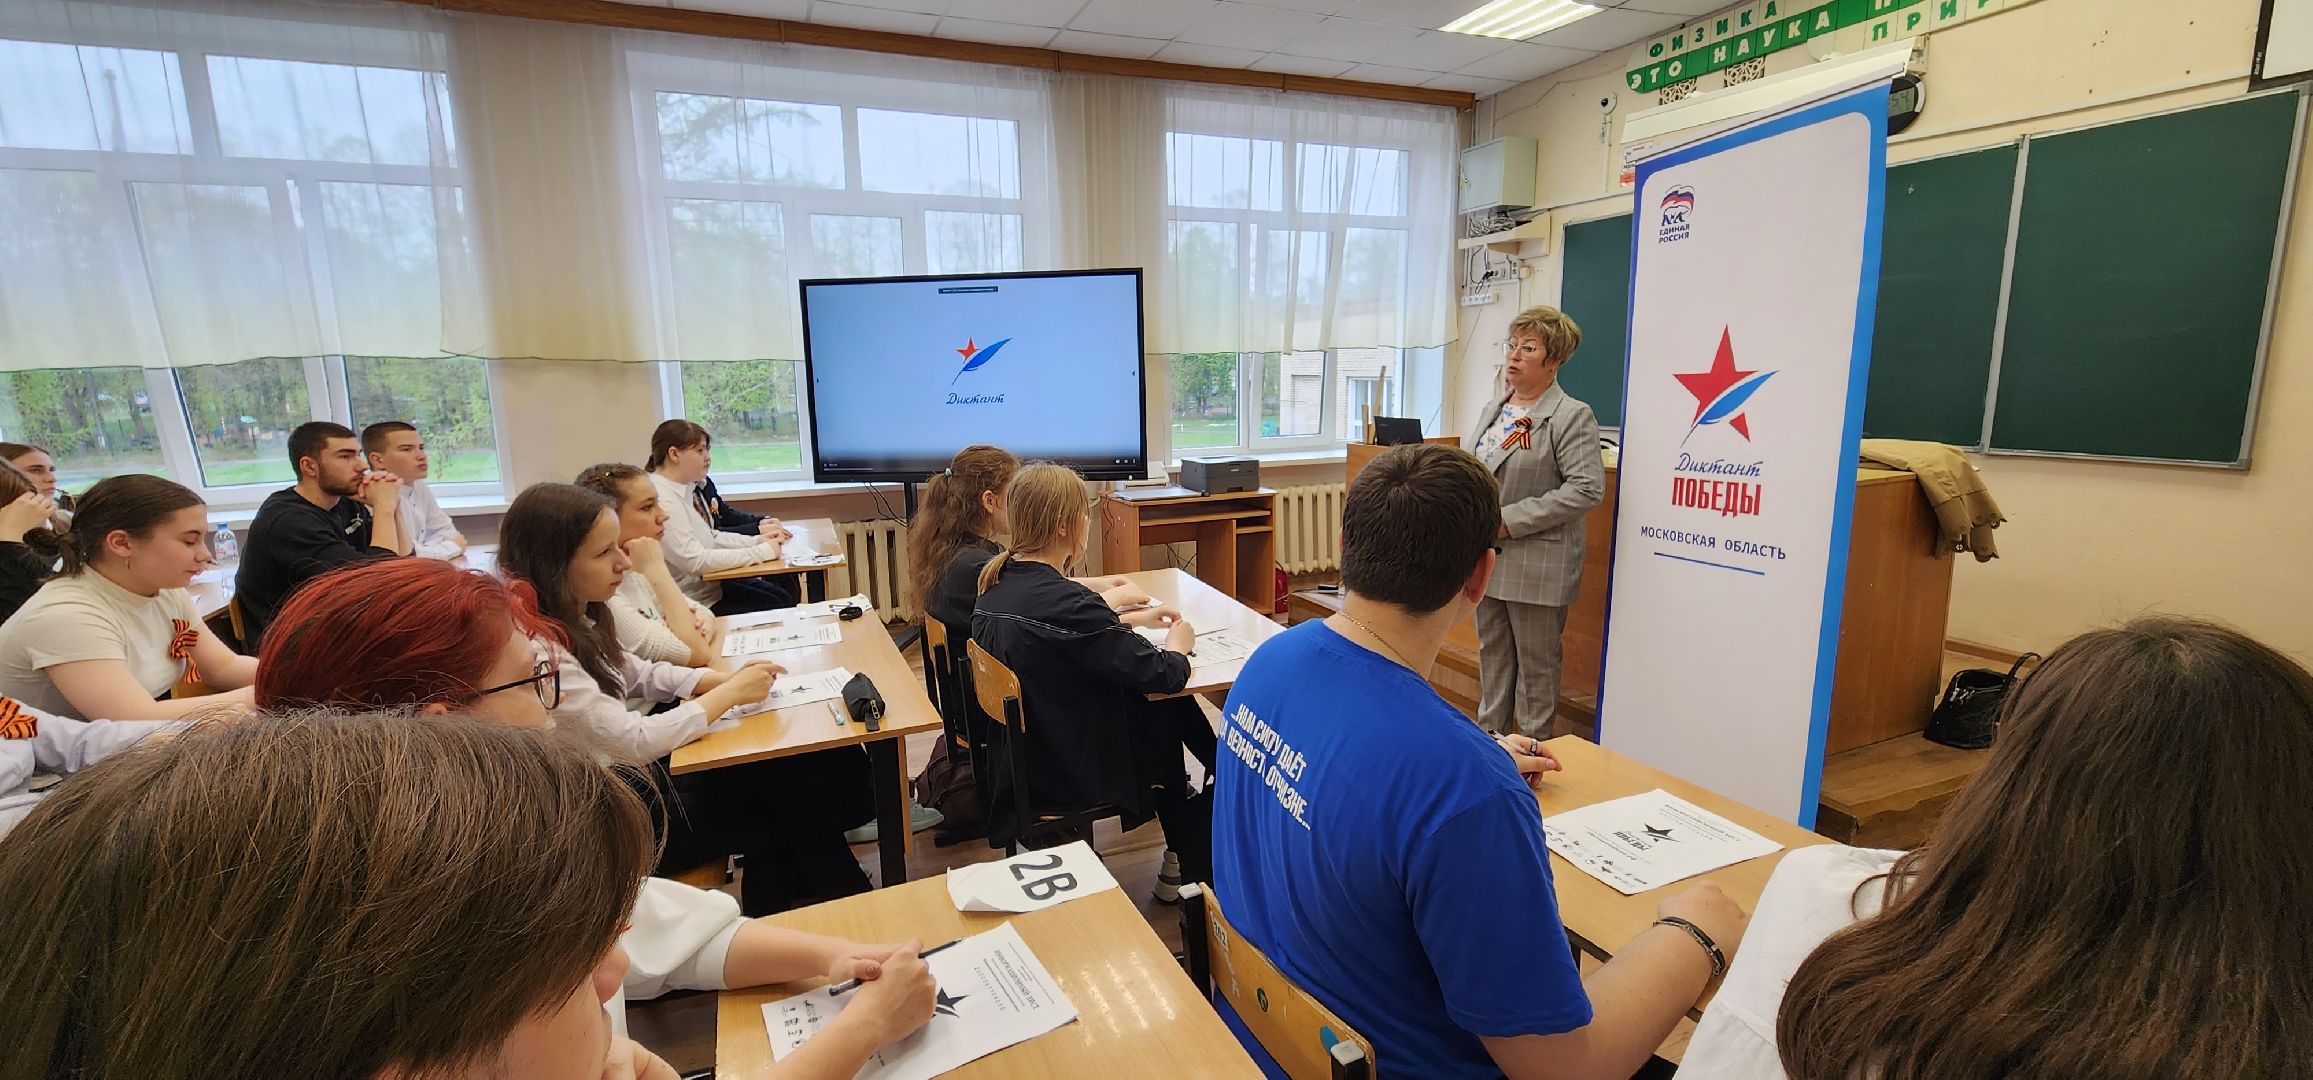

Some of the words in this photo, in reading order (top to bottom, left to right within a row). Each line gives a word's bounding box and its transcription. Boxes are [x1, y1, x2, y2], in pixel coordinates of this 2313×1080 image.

[1650, 1, 1777, 57] ФИЗИКА
[1631, 60, 1683, 90] ЭТО
[1714, 11, 1831, 63] НАУКА
[1659, 224, 1690, 236] ЕДИНАЯ
[1659, 232, 1690, 243] РОССИЯ
[946, 392, 1005, 405] Диктант
[1675, 452, 1764, 477] Диктант
[1671, 476, 1762, 517] ПОБЕДЫ
[1640, 526, 1716, 549] МОСКОВСКАЯ
[1725, 539, 1786, 560] ОБЛАСТЬ
[1253, 719, 1284, 756] СИЛУ
[1277, 743, 1308, 783] ДАЁТ
